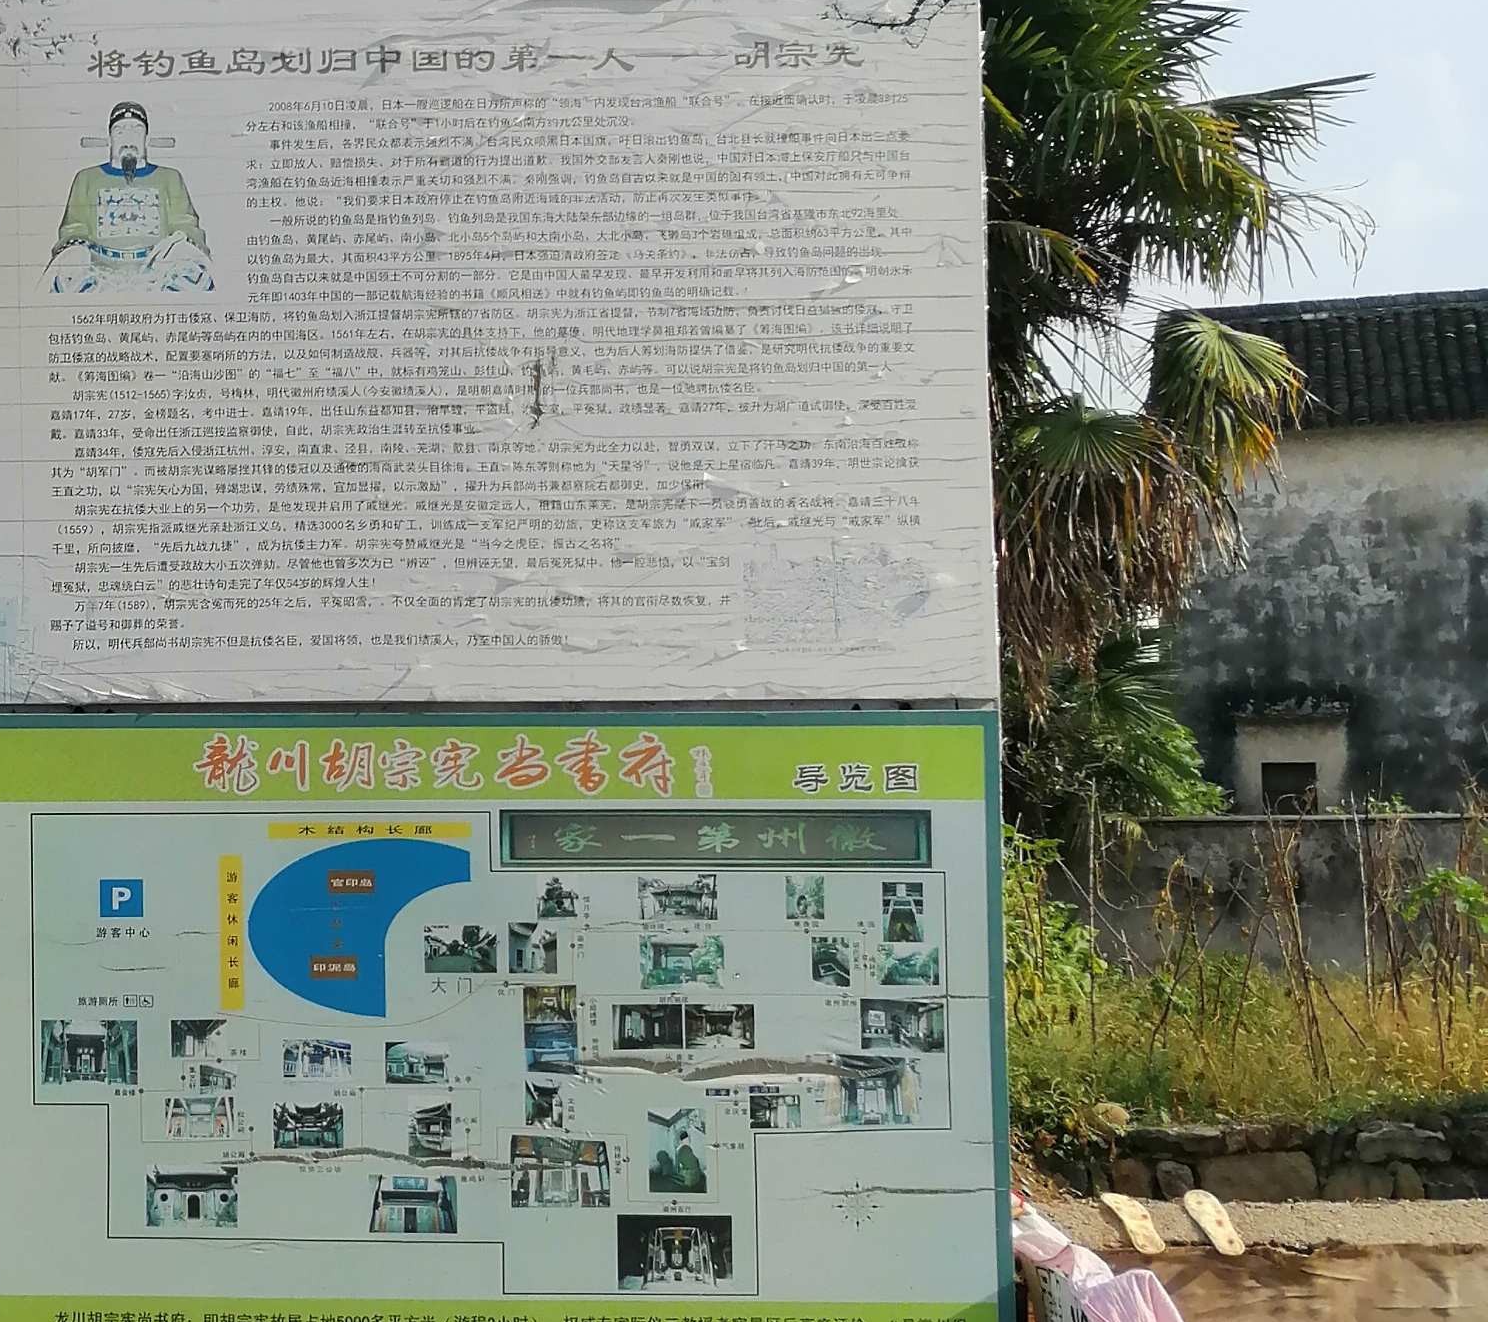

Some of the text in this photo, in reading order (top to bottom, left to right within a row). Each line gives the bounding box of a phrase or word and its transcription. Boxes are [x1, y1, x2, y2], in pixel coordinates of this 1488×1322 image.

[792, 762, 920, 793] 导览图
[298, 824, 432, 837] 木结构长廊
[111, 887, 132, 910] P
[95, 926, 151, 939] 游客中心
[226, 871, 240, 990] 游客休闲长廊
[430, 977, 473, 994] 大门
[78, 995, 119, 1008] 旅游厕所
